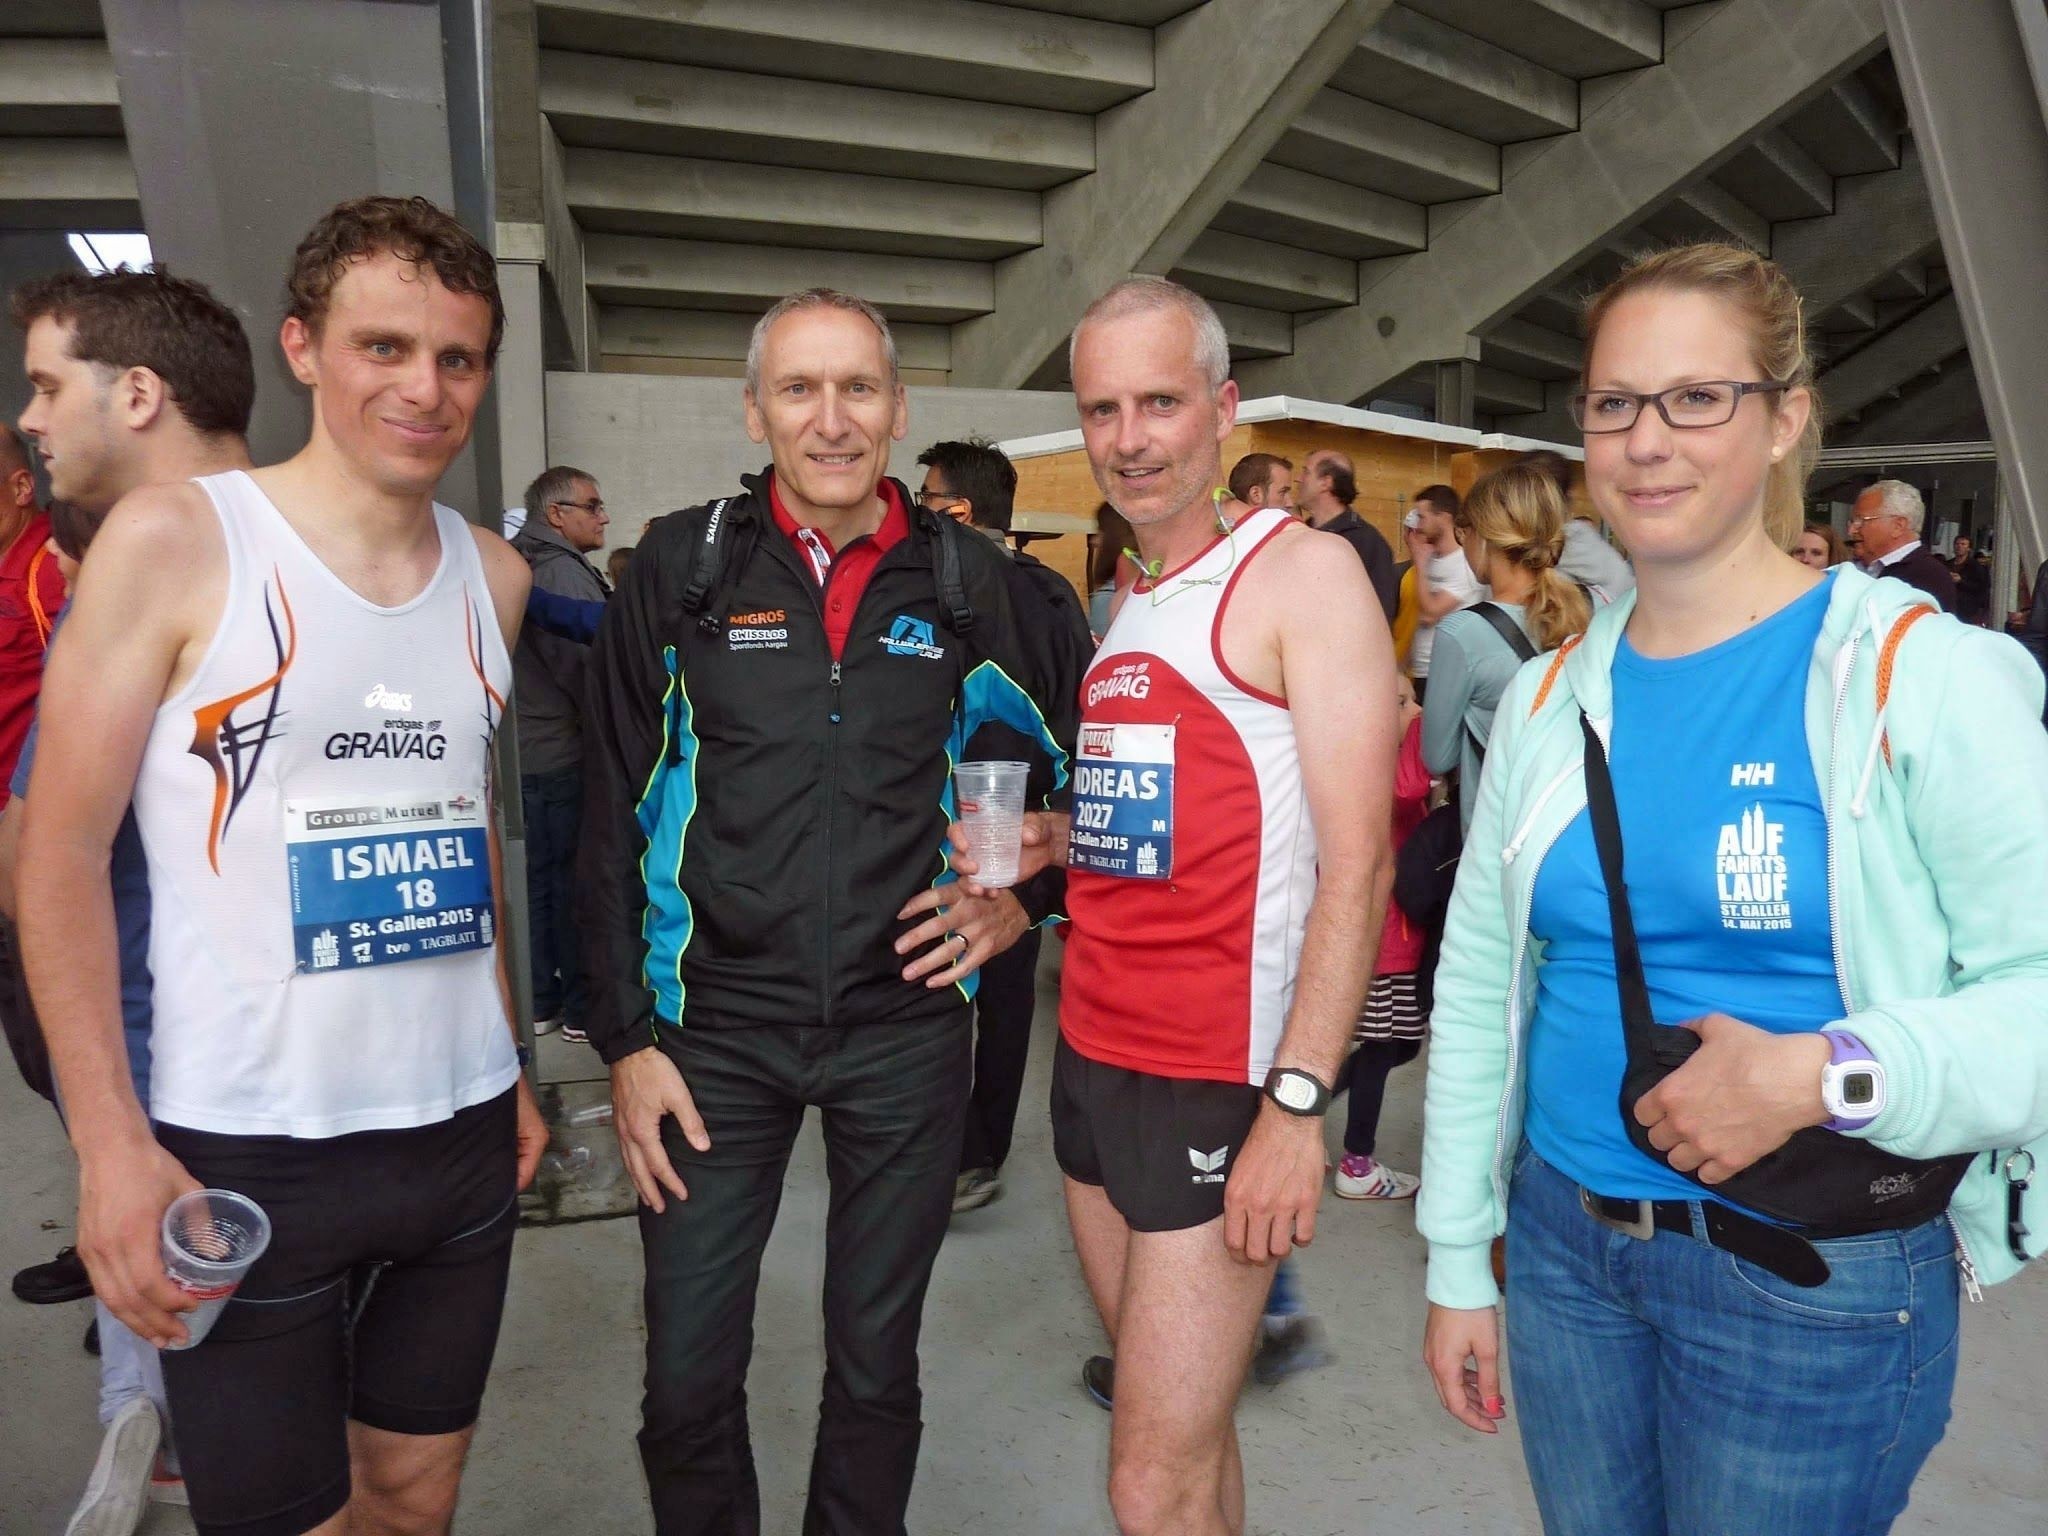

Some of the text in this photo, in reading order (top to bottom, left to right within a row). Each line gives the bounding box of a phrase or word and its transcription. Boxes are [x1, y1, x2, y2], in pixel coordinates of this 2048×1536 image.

[706, 499, 728, 545] SALOMON
[730, 609, 786, 625] MIGROS
[729, 629, 788, 641] SWISSLOS
[765, 641, 788, 650] Aargau
[1088, 674, 1151, 707] GRAVAG
[384, 717, 425, 731] erdgas
[325, 731, 448, 760] GRAVAG
[1073, 766, 1159, 800] NDREAS
[1730, 762, 1775, 786] HH
[309, 803, 440, 826] Groupe Mutuel
[1076, 801, 1113, 829] 2027
[1152, 820, 1166, 832] M
[1076, 831, 1100, 847] Gallen
[1100, 835, 1129, 850] 2015
[1717, 801, 1784, 856] AUF
[331, 836, 474, 881] ISMAEL
[1717, 855, 1787, 873] FAHRTS
[396, 879, 437, 910] 18
[1717, 873, 1788, 902] LAUF
[349, 922, 377, 939] St.
[379, 914, 438, 934] Gallen
[439, 908, 474, 926] 2015
[1722, 918, 1792, 930] 14. MAI 2015
[419, 931, 477, 950] TAGBLATT
